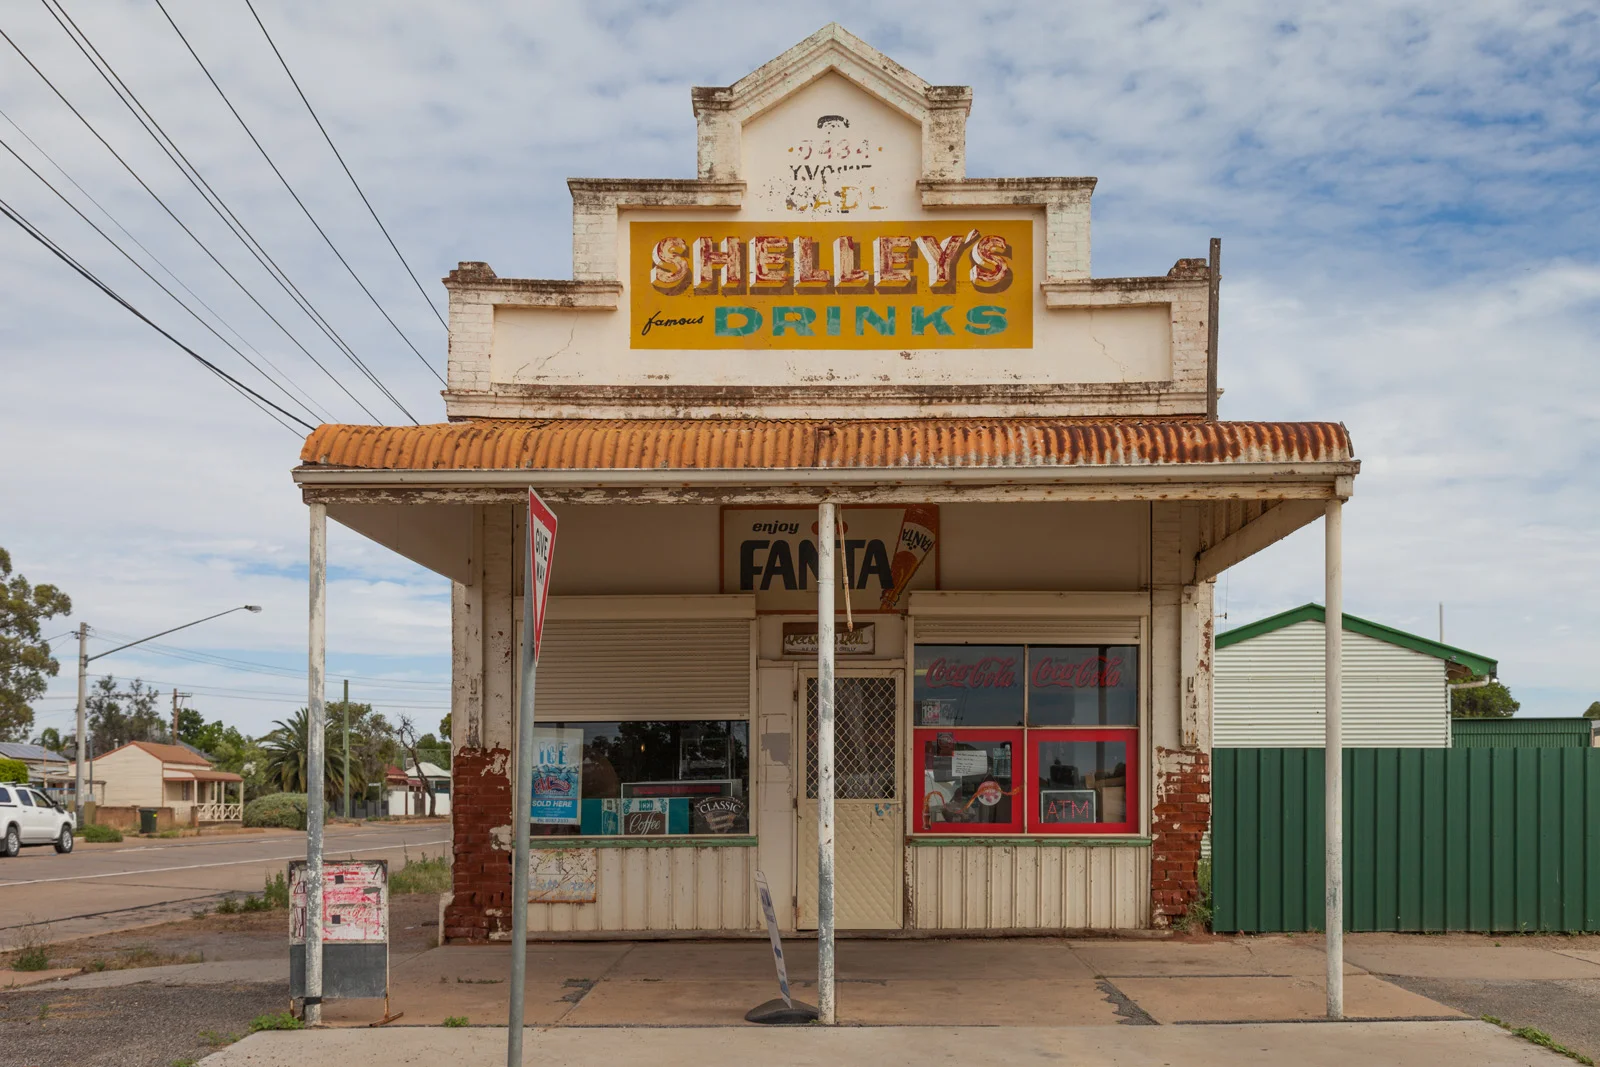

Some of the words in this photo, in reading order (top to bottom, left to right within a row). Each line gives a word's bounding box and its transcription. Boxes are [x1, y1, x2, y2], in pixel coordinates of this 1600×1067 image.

[650, 229, 1013, 295] SHELLEY'S
[641, 311, 704, 336] famous
[714, 305, 1009, 337] DRINKS
[752, 520, 800, 534] enjoy
[535, 527, 549, 562] GIVE
[740, 539, 895, 591] FANTA
[925, 657, 1018, 689] Coca-Cola
[1032, 656, 1124, 689] Coca-Cola
[538, 741, 569, 765] ICE
[629, 811, 661, 835] Coffee
[699, 800, 742, 814] CLASSIC
[1045, 800, 1090, 819] ATM
